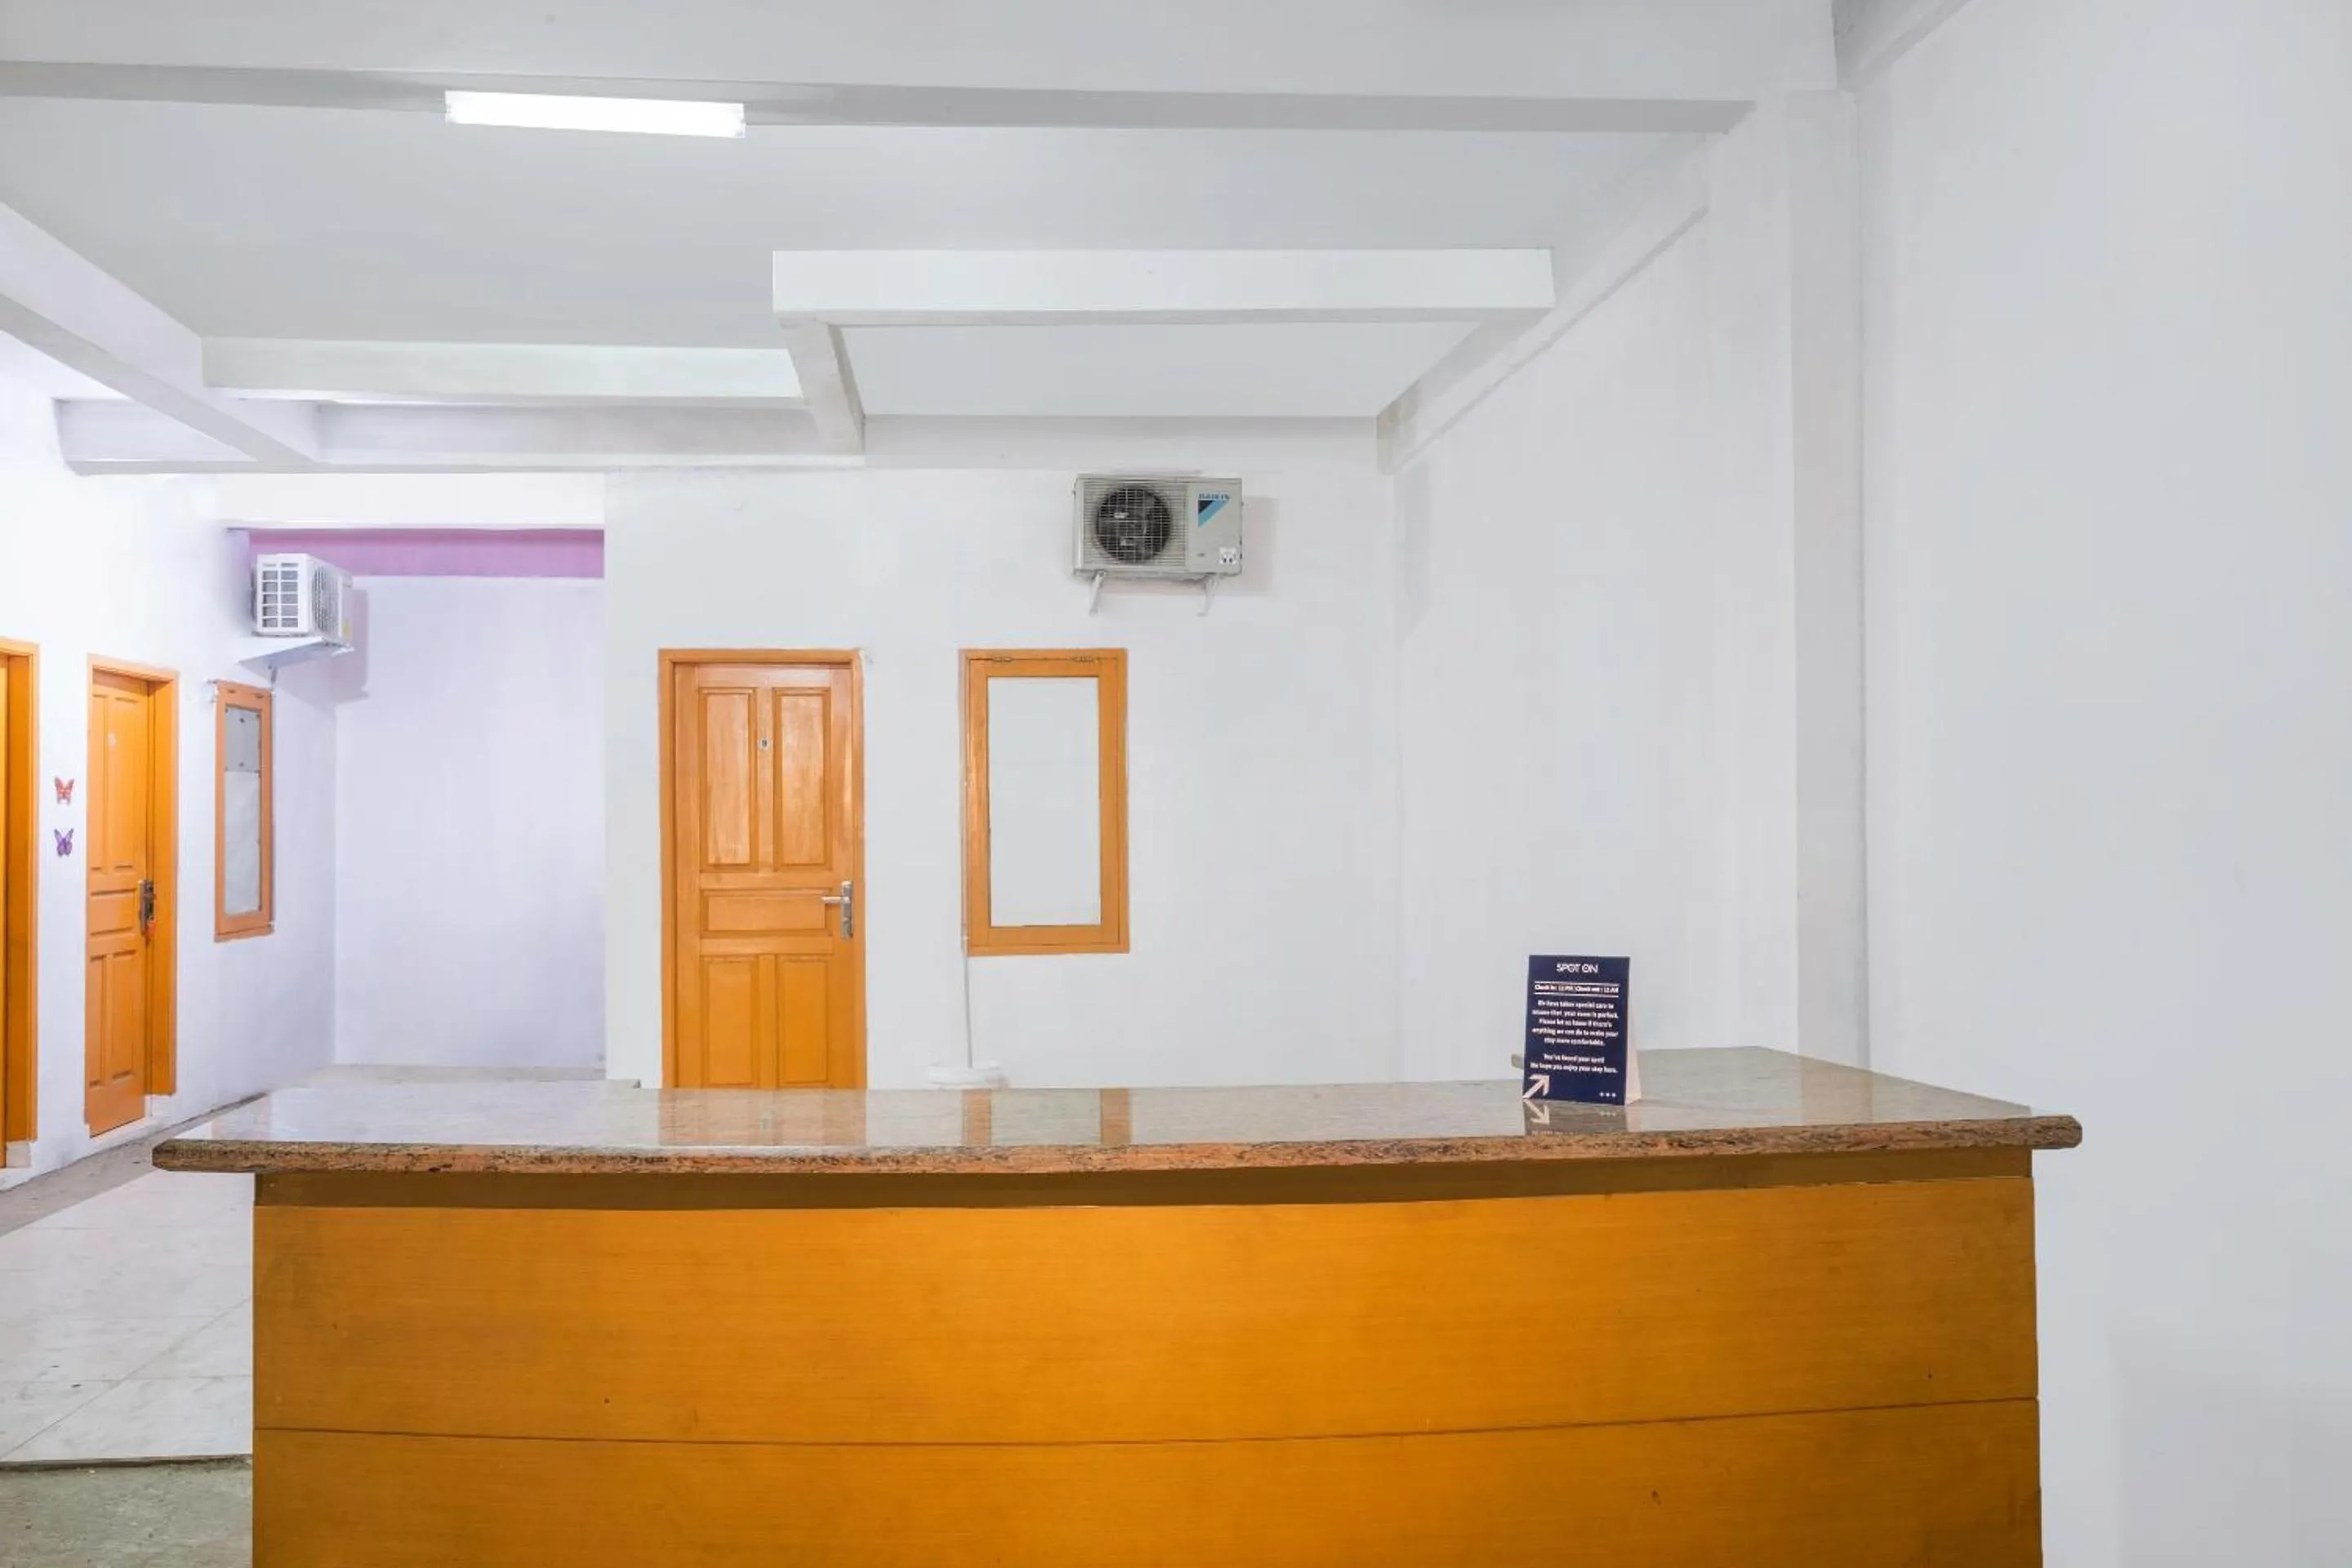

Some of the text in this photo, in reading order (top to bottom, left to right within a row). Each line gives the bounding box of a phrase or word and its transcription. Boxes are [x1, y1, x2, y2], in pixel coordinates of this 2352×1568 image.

[1556, 963, 1599, 973] SPOT ON
[1575, 1001, 1595, 1009] special
[1532, 1027, 1556, 1036] anything
